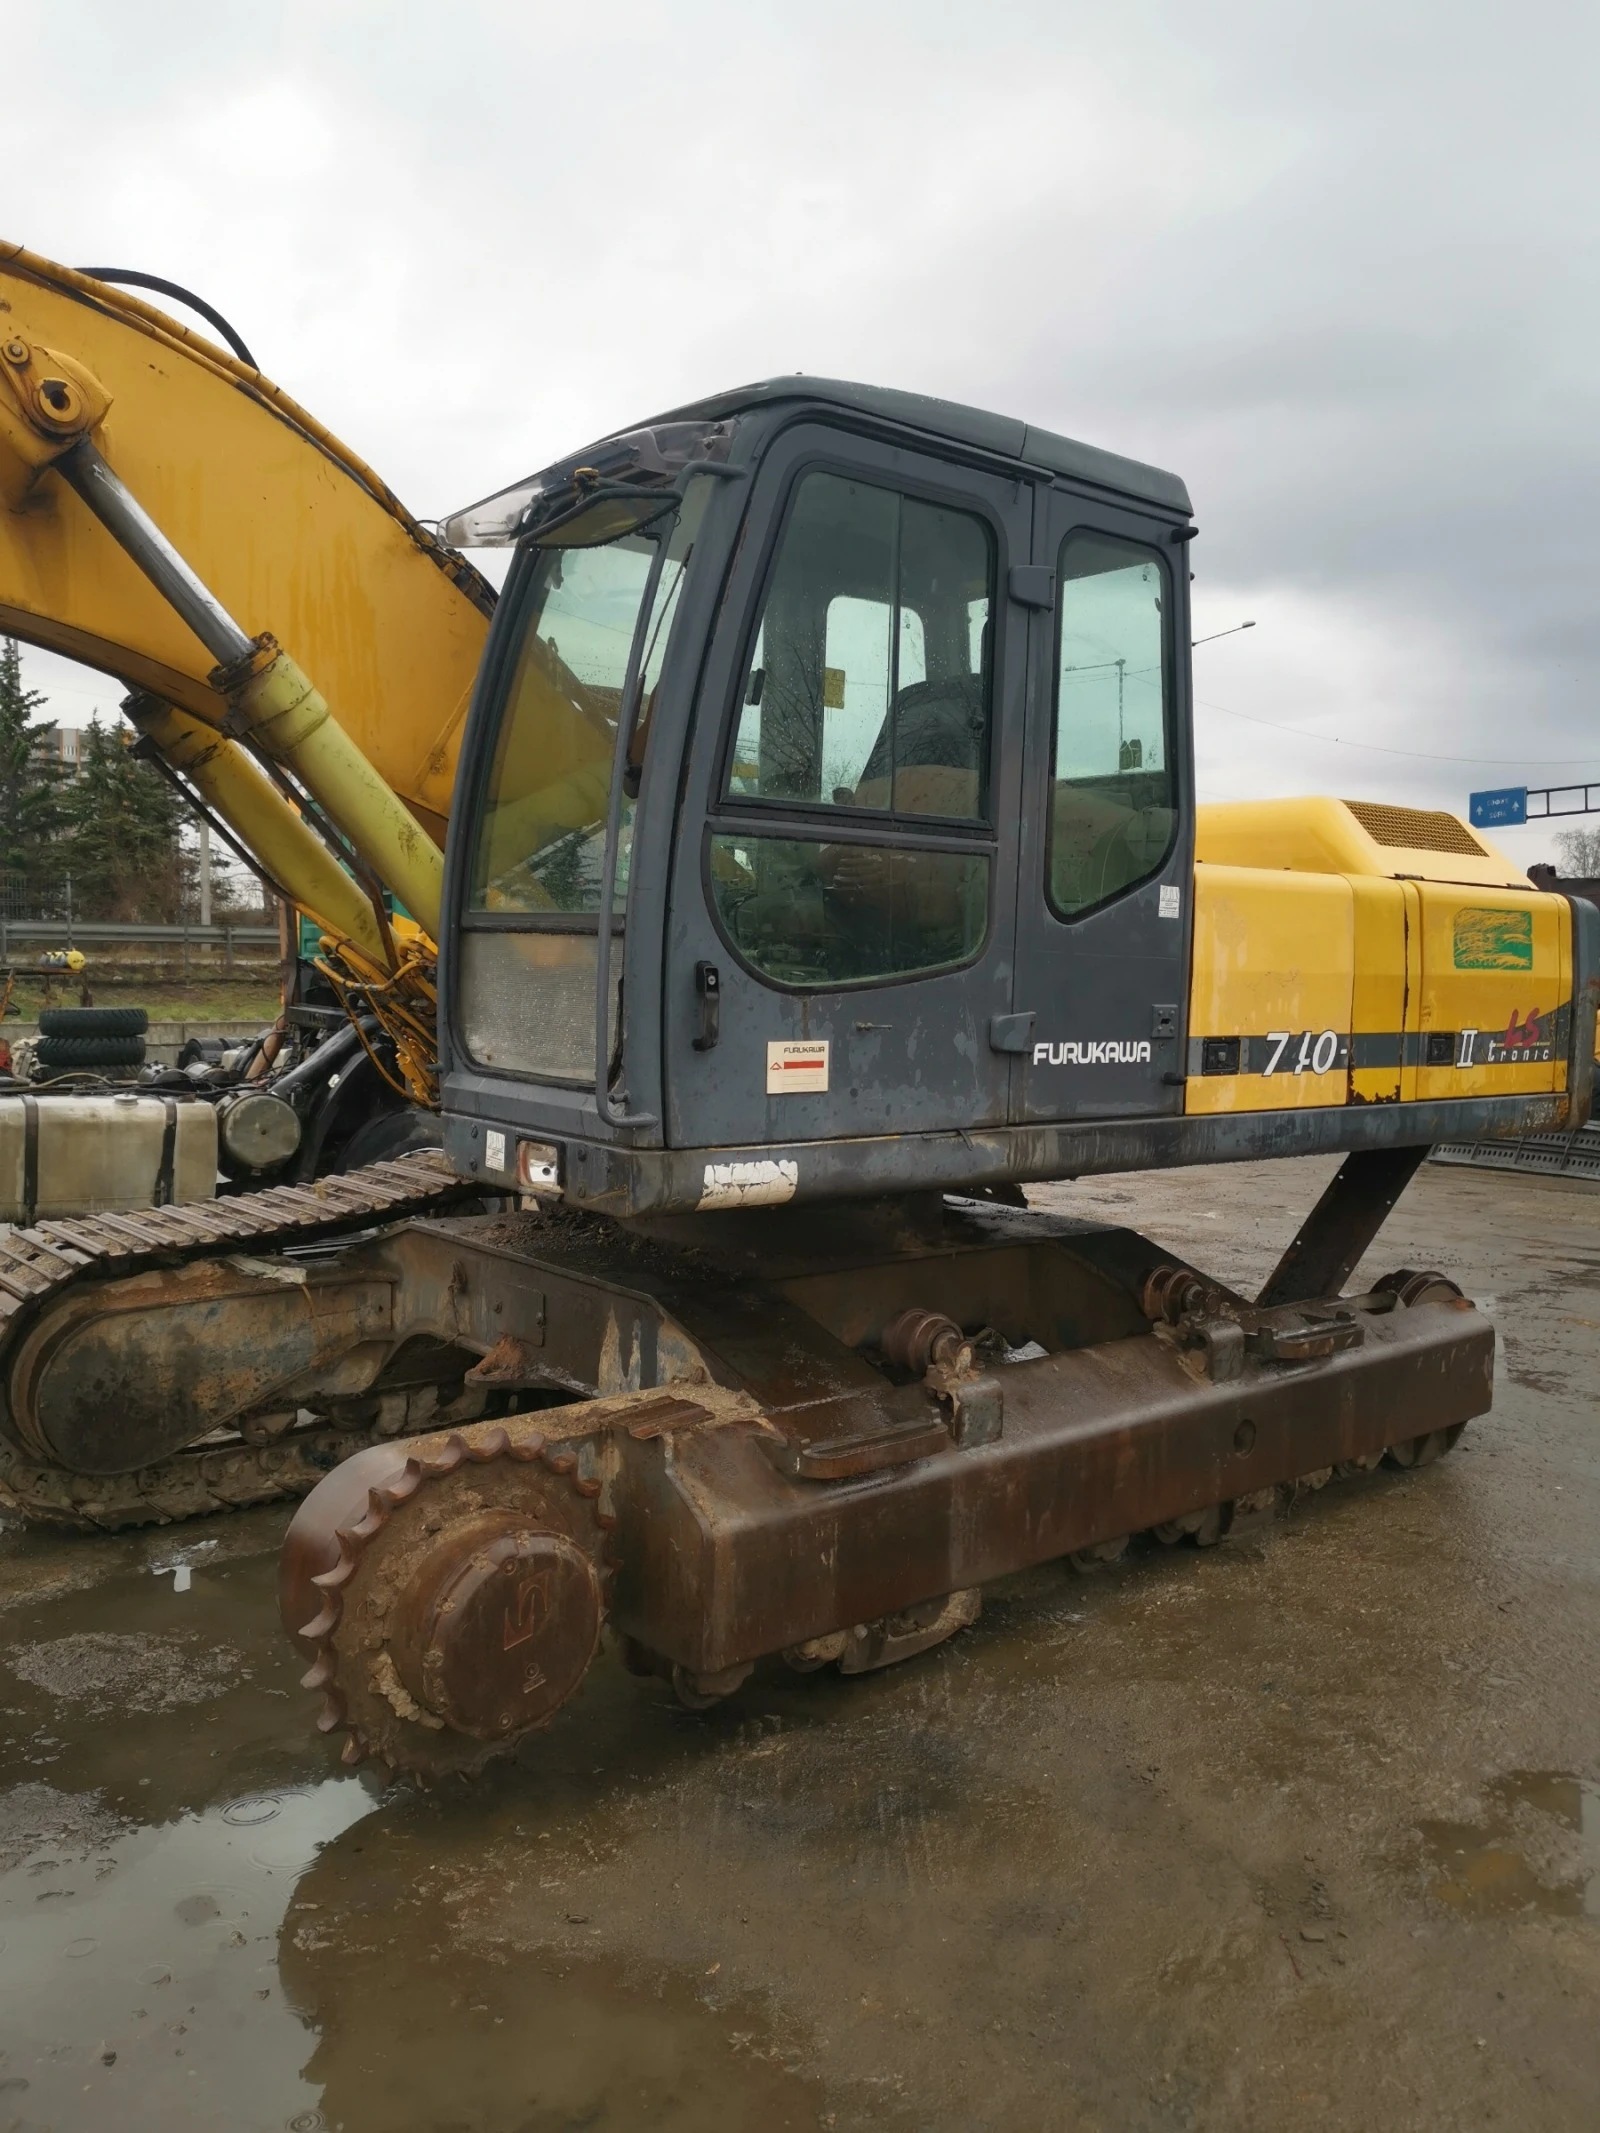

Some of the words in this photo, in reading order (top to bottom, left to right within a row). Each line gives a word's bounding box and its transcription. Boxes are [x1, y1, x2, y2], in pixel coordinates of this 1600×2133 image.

[783, 1046, 825, 1054] FURUKAWA
[1033, 1041, 1151, 1066] FURUKAWA
[1487, 1040, 1550, 1062] tronic
